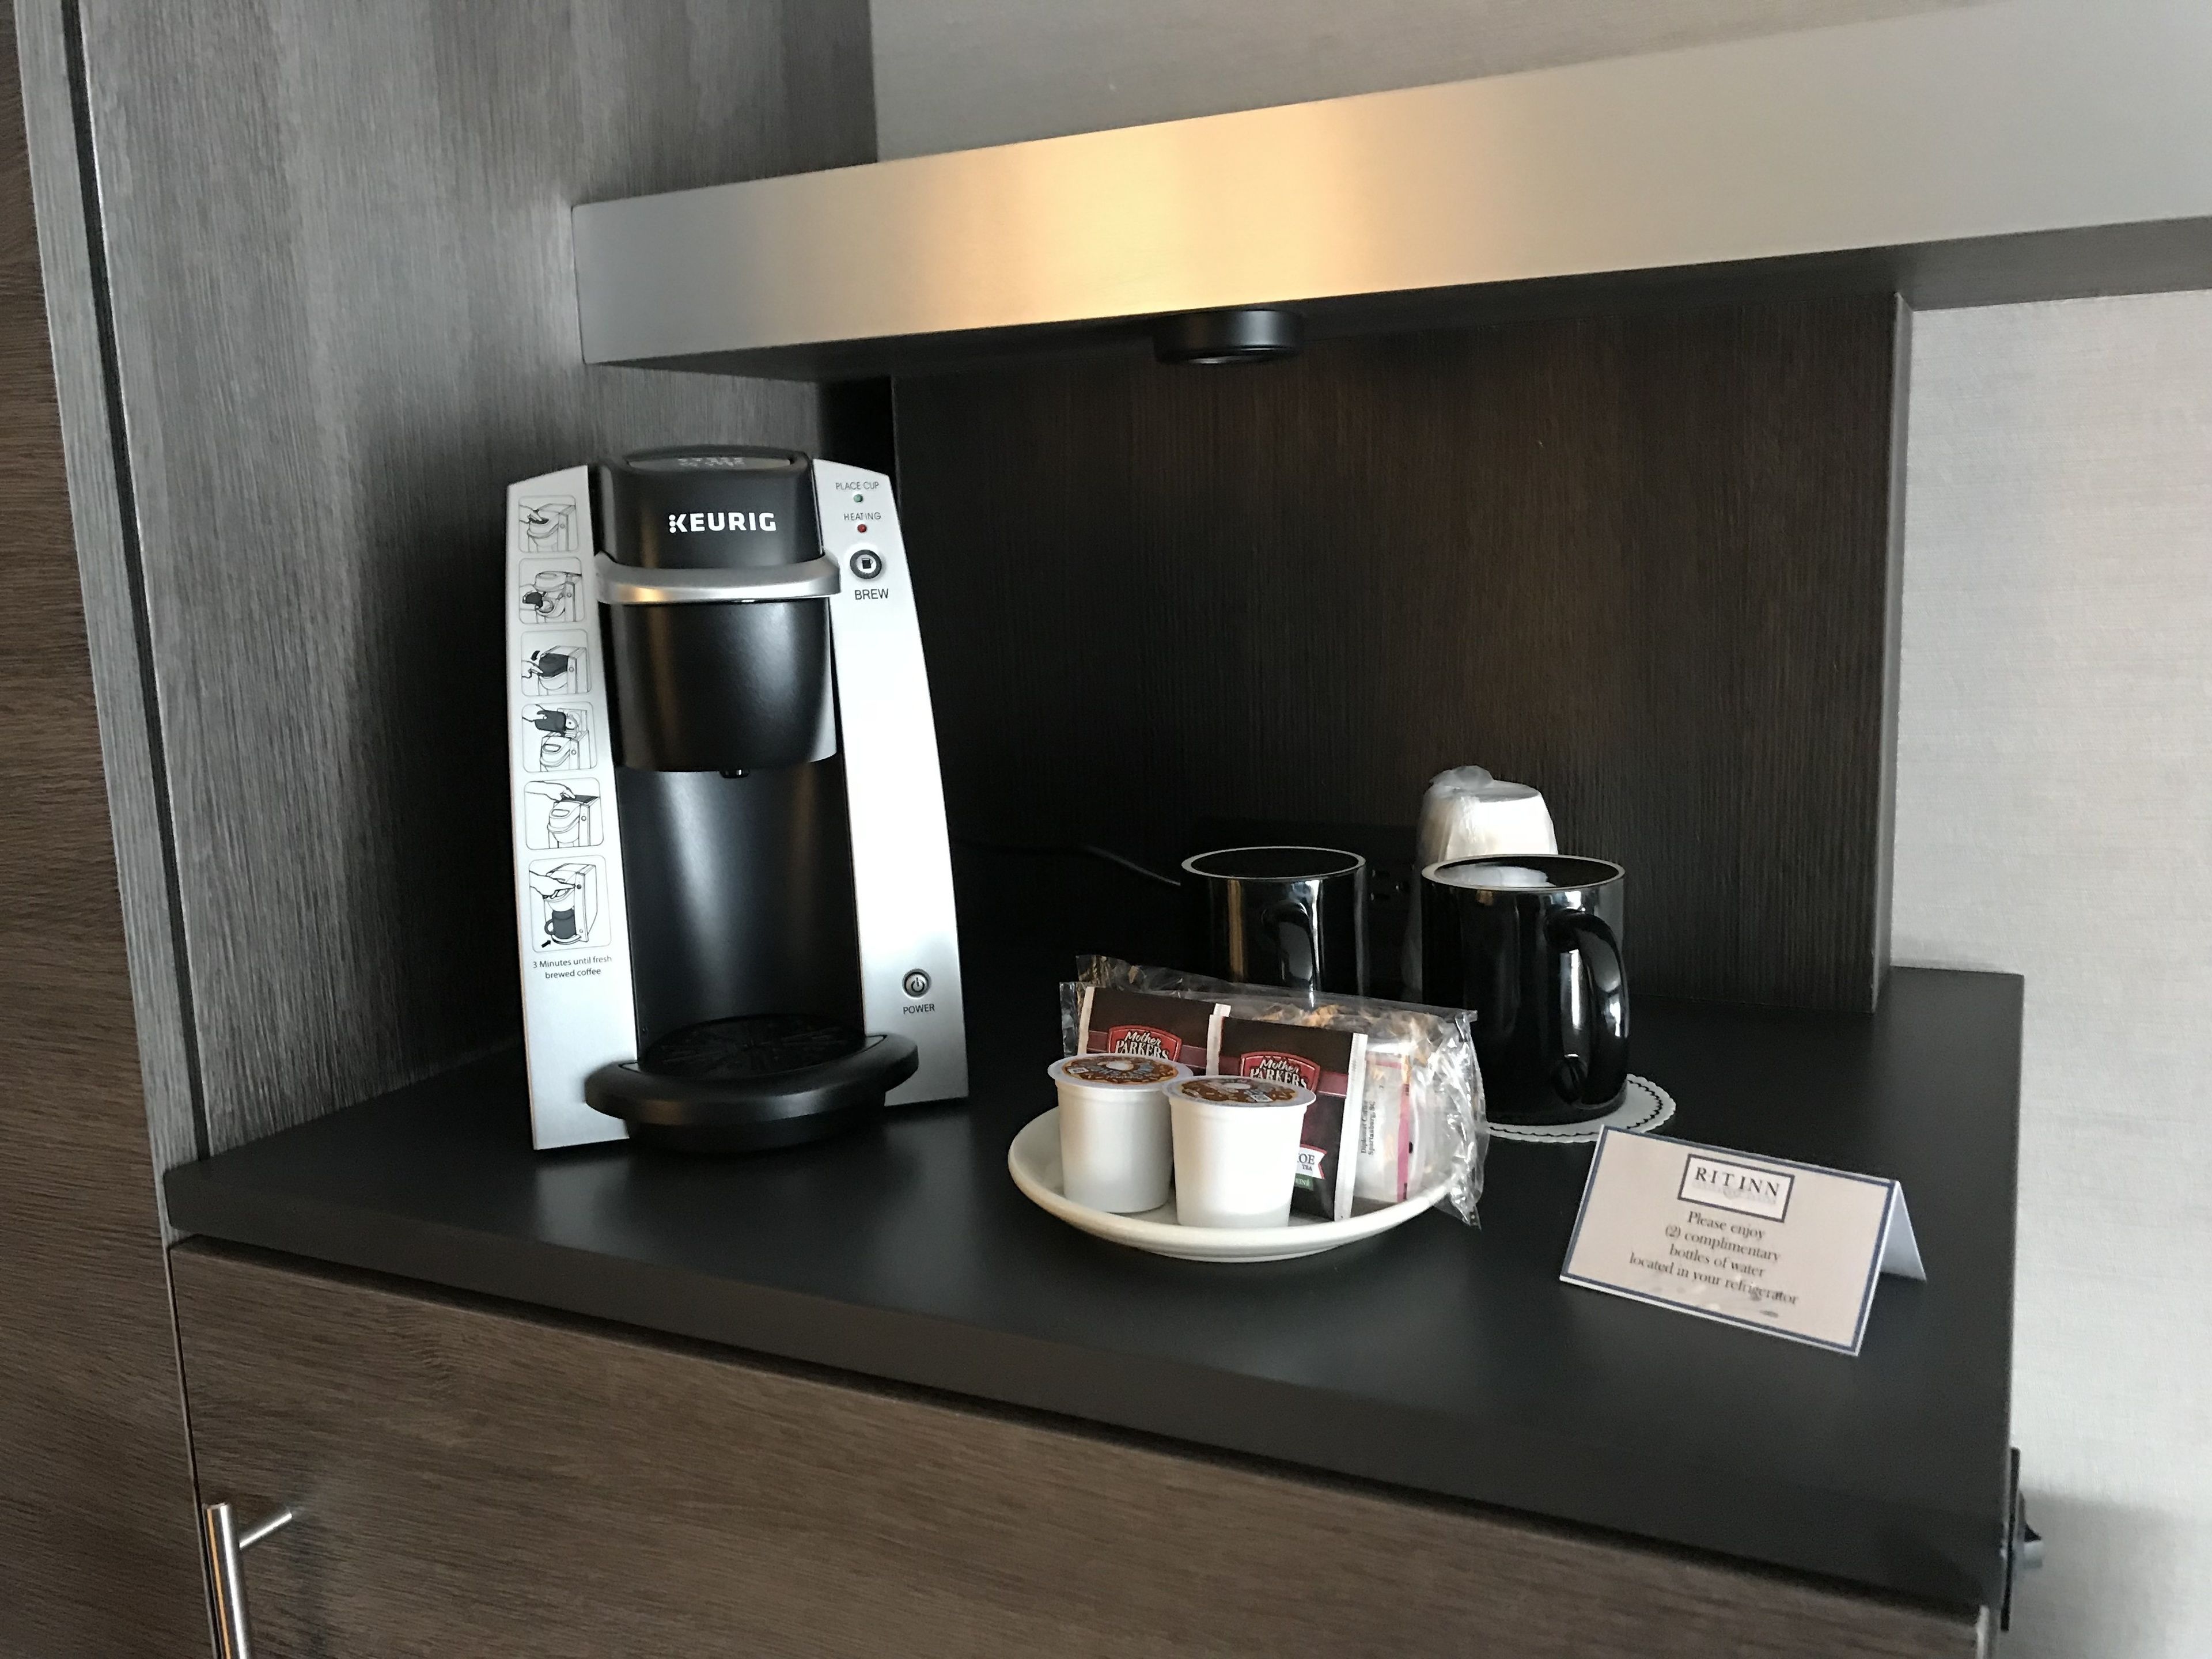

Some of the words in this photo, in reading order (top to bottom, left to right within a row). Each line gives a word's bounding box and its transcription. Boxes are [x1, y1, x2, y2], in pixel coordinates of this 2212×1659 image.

[835, 482, 861, 490] PLACE
[863, 481, 879, 489] CUP
[669, 512, 777, 533] KEURIG
[843, 512, 881, 520] HEATING
[855, 588, 889, 600] BREW
[539, 959, 571, 968] Minutes
[573, 957, 591, 965] until
[545, 969, 575, 979] brewed
[577, 968, 601, 976] coffee
[903, 1003, 935, 1014] POWER
[1124, 1031, 1161, 1047] Mother
[1115, 1040, 1170, 1060] PARKERS
[1259, 1059, 1300, 1074] Mother
[1695, 1166, 1734, 1187] RIT
[1738, 1176, 1780, 1197] INN
[1688, 1211, 1727, 1230] Please
[1730, 1224, 1766, 1239] enjoy
[1665, 1225, 1681, 1238] (2)
[1684, 1232, 1782, 1263] complimentary
[1669, 1244, 1710, 1264] bottles
[1714, 1257, 1729, 1268] of
[1731, 1262, 1765, 1277] water
[1629, 1252, 1674, 1274] located
[1676, 1267, 1689, 1278] in
[1693, 1271, 1721, 1285] your
[1725, 1279, 1798, 1305] refrigerator
